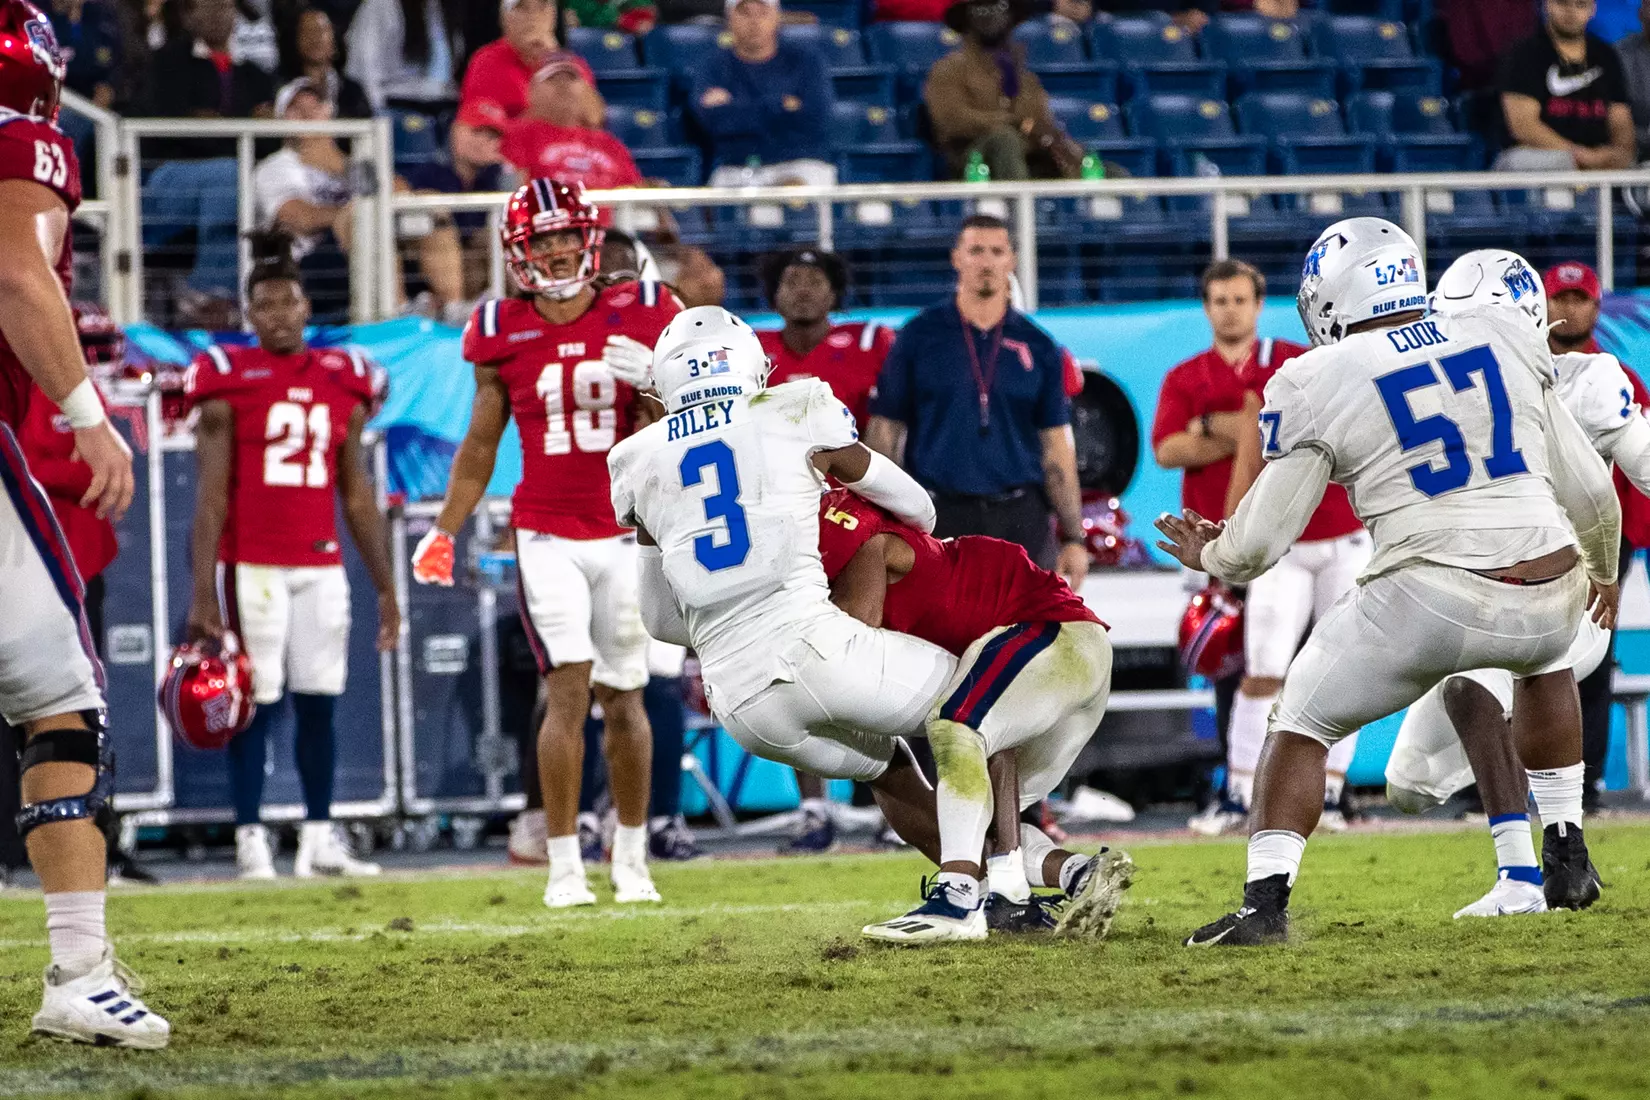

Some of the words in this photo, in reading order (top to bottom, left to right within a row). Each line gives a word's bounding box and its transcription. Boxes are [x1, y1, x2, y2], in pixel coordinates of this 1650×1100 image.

[33, 139, 68, 189] 63
[1375, 264, 1397, 286] 57
[1372, 300, 1397, 315] BLUE
[1399, 295, 1427, 309] RAIDERS
[1386, 321, 1449, 353] COOK
[687, 358, 700, 377] 3
[536, 360, 617, 456] 18
[680, 391, 702, 405] BLUE
[704, 385, 743, 399] RAIDERS
[668, 399, 734, 442] RILEY
[1259, 410, 1283, 454] 7
[1372, 343, 1531, 500] 57
[263, 401, 331, 489] 21
[678, 437, 753, 575] 3
[824, 506, 859, 531] 5
